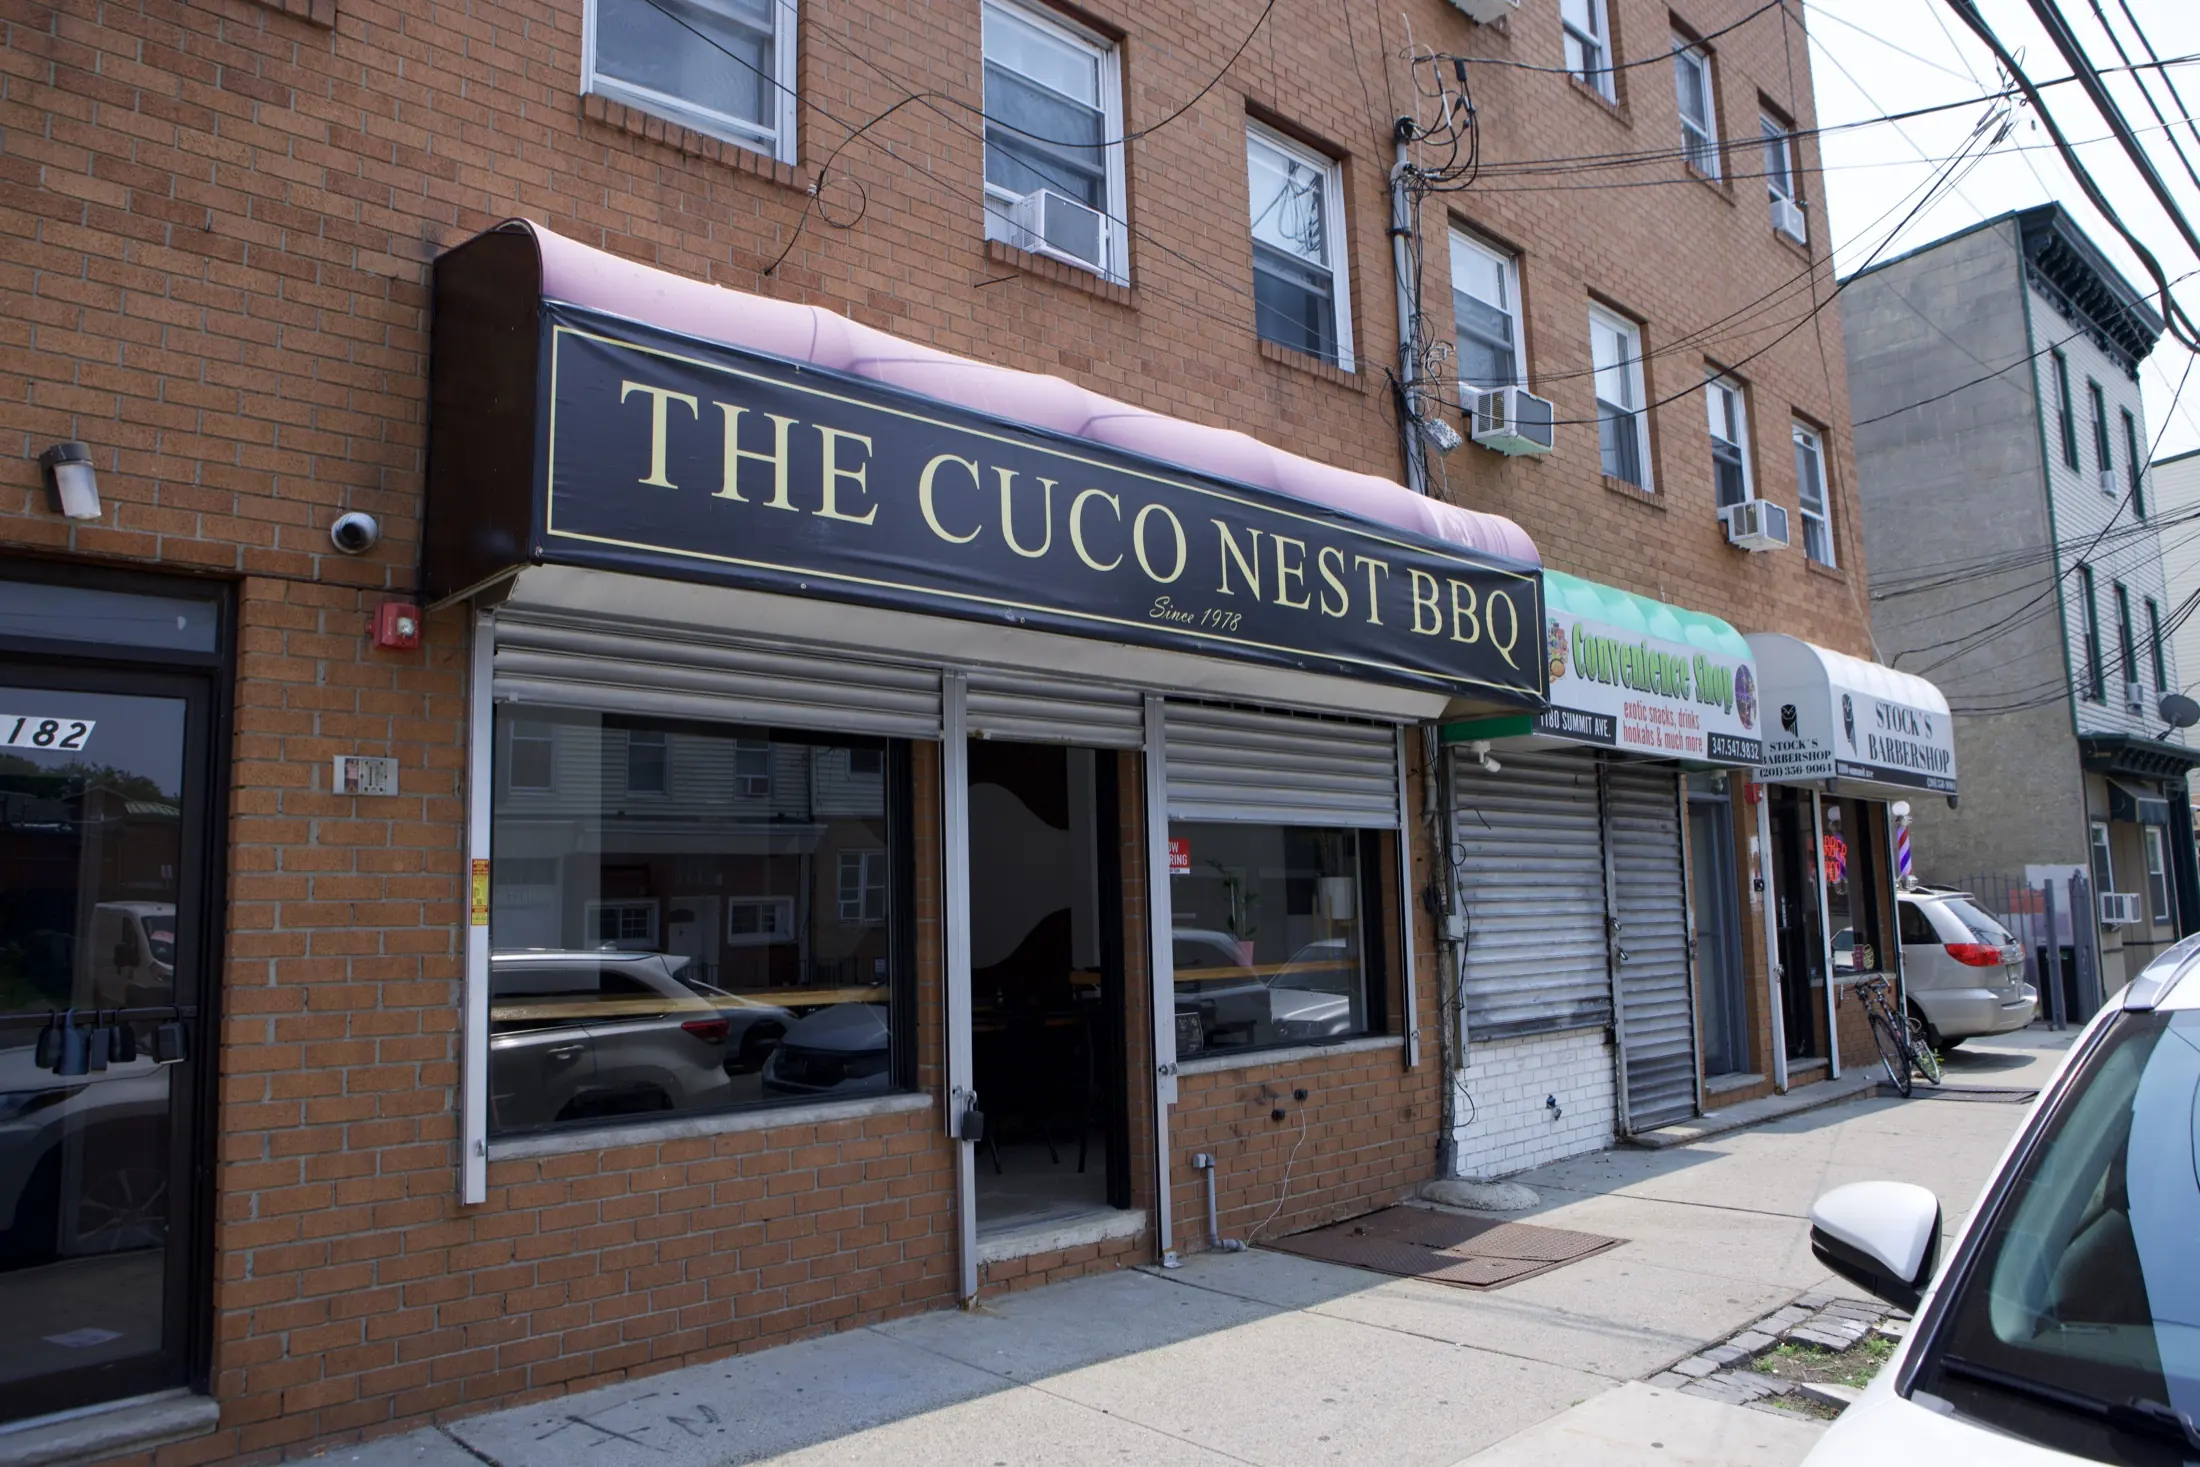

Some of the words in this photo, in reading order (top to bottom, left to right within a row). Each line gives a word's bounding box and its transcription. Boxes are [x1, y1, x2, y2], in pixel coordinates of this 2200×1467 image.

[620, 379, 879, 526] THE
[918, 453, 1188, 585] CUCO
[1210, 518, 1389, 625] NEST
[1406, 567, 1520, 671] BBQ
[1149, 595, 1195, 624] Since
[1200, 608, 1242, 632] 1978
[1571, 622, 1690, 701] Convenience
[1692, 652, 1734, 715] Shop
[1540, 708, 1560, 729] 1180
[1562, 711, 1593, 736] SUMMIT
[1594, 717, 1611, 738] AVE.
[1623, 699, 1647, 721] exotic
[1648, 704, 1677, 730] snacks,
[1678, 708, 1700, 730] drinks
[7, 717, 87, 749] 182
[1623, 719, 1655, 747] hookahs
[1656, 726, 1663, 748] &
[1664, 729, 1683, 751] much
[1685, 735, 1703, 753] more
[1711, 736, 1760, 761] 347.547.9832
[1867, 733, 1950, 774] BARBERSHOP
[1759, 767, 1783, 779] (201)
[1168, 841, 1179, 853] OW
[1169, 854, 1188, 866] RING
